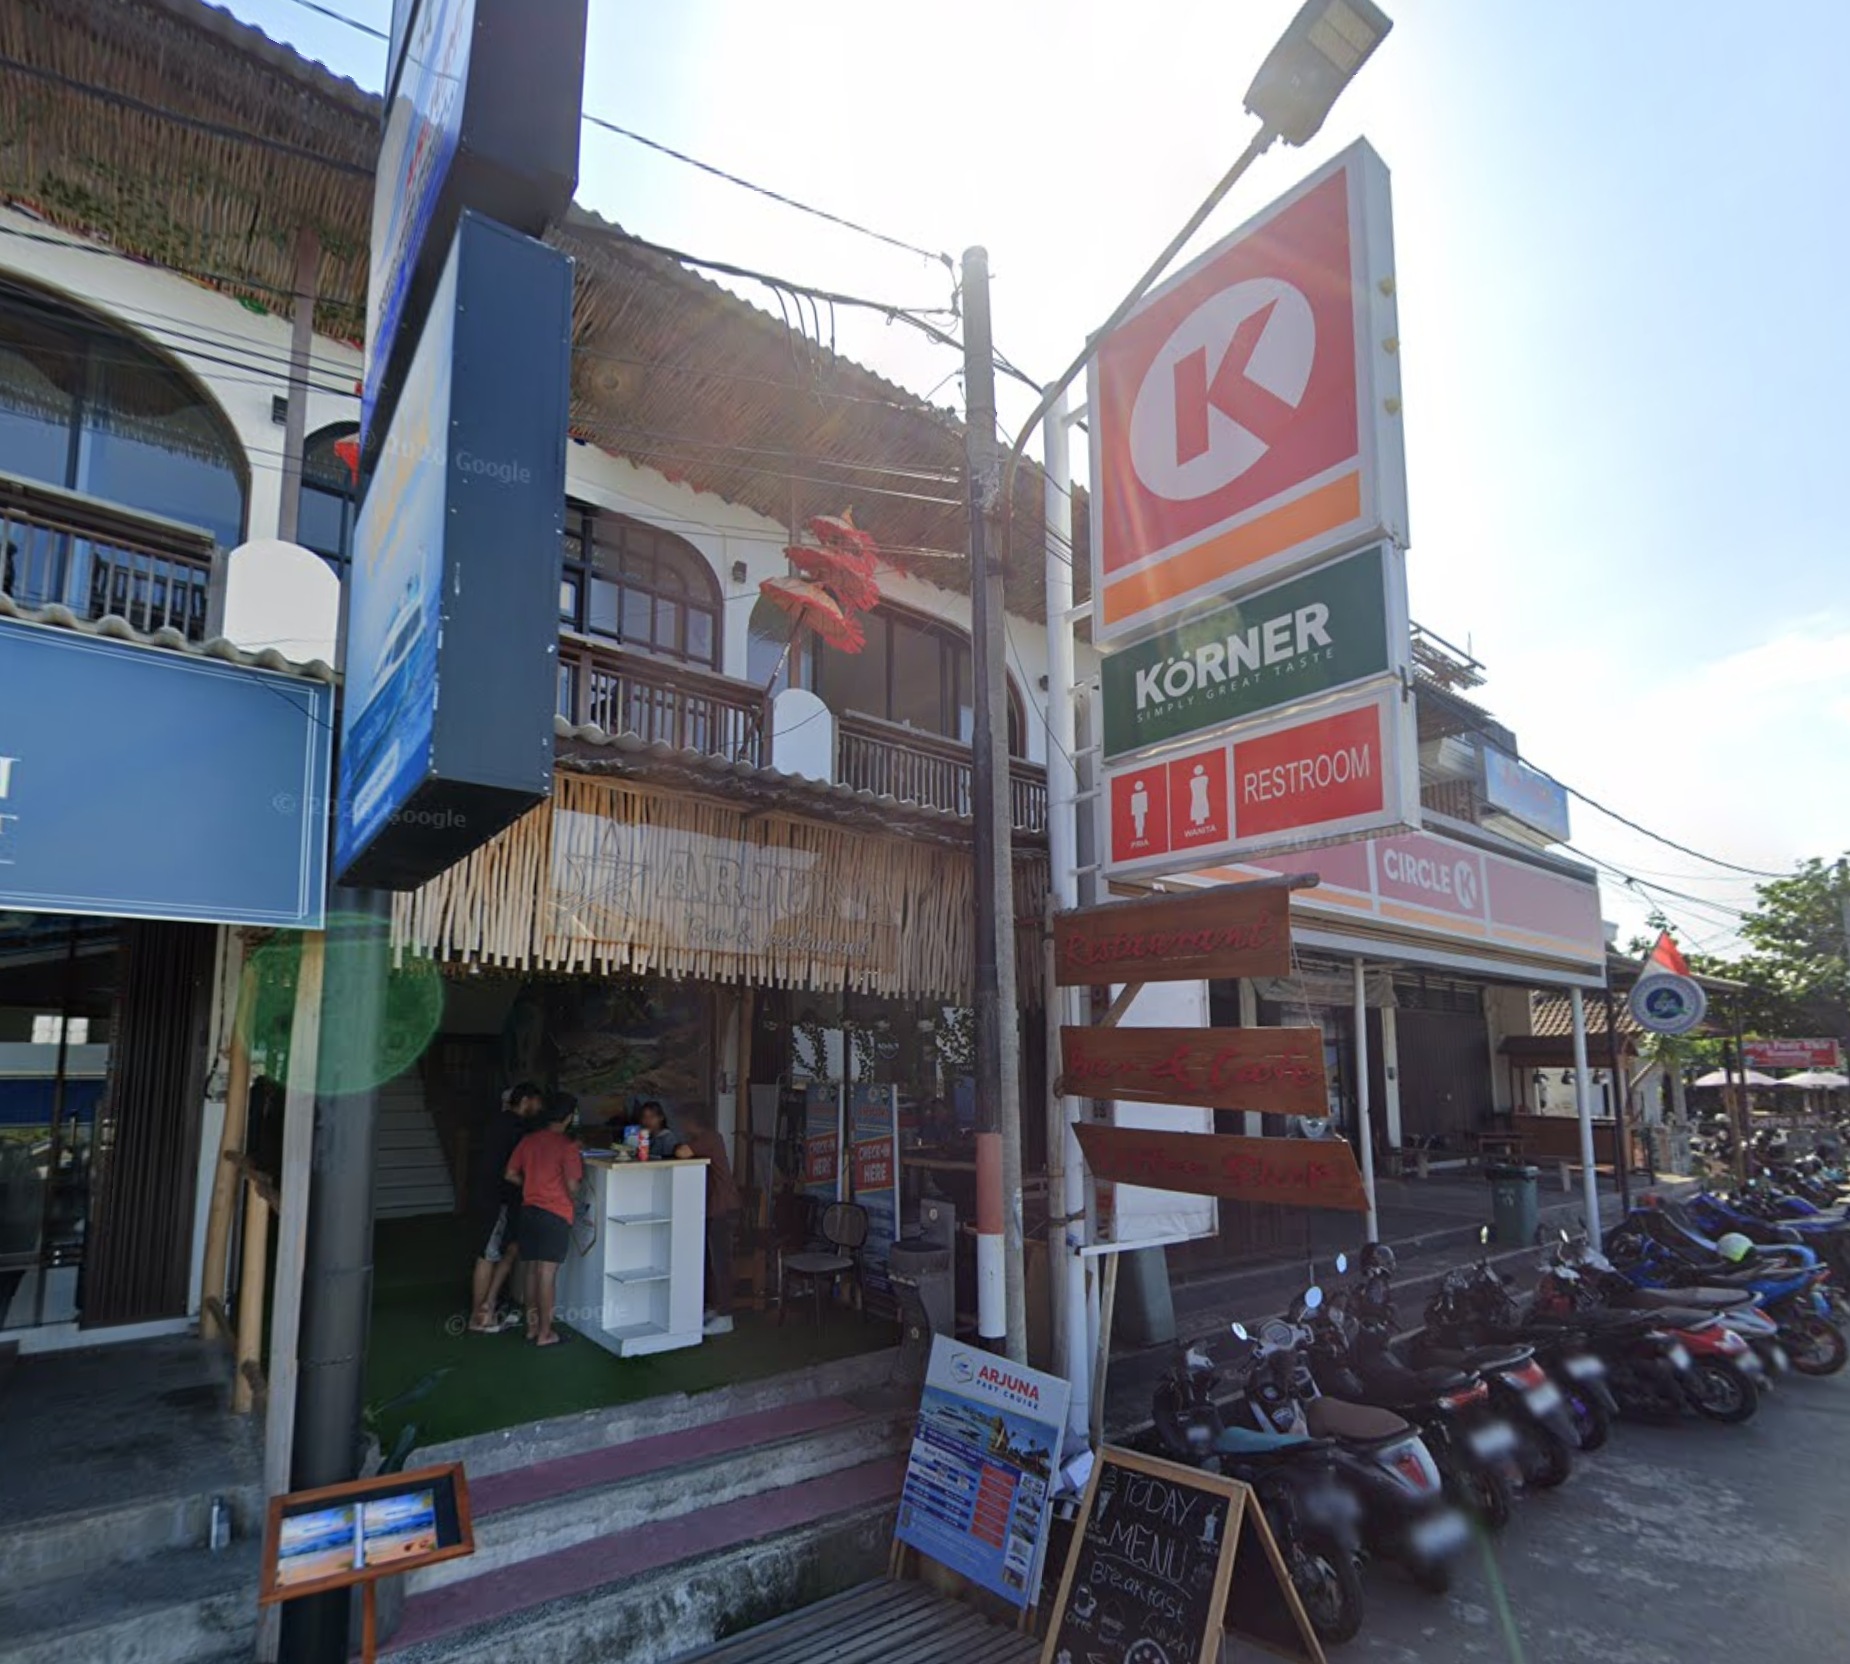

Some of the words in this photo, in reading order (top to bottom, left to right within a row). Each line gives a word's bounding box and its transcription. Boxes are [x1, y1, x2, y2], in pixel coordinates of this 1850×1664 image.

[1168, 292, 1304, 474] K
[1136, 602, 1333, 710] KÖRNER
[1137, 696, 1194, 724] SIMPLY
[1206, 674, 1261, 700] GREAT
[1274, 647, 1334, 676] TASTE
[1244, 744, 1370, 804] RESTROOM
[1130, 838, 1150, 850] PRIA
[1184, 824, 1217, 838] WANITA
[1383, 848, 1452, 895] CIRCLE
[1453, 860, 1478, 910] K
[863, 1161, 887, 1184] HERE
[979, 1365, 1040, 1401] ARJUNA
[1122, 1472, 1198, 1527] TODAY
[1108, 1520, 1189, 1584] MENU
